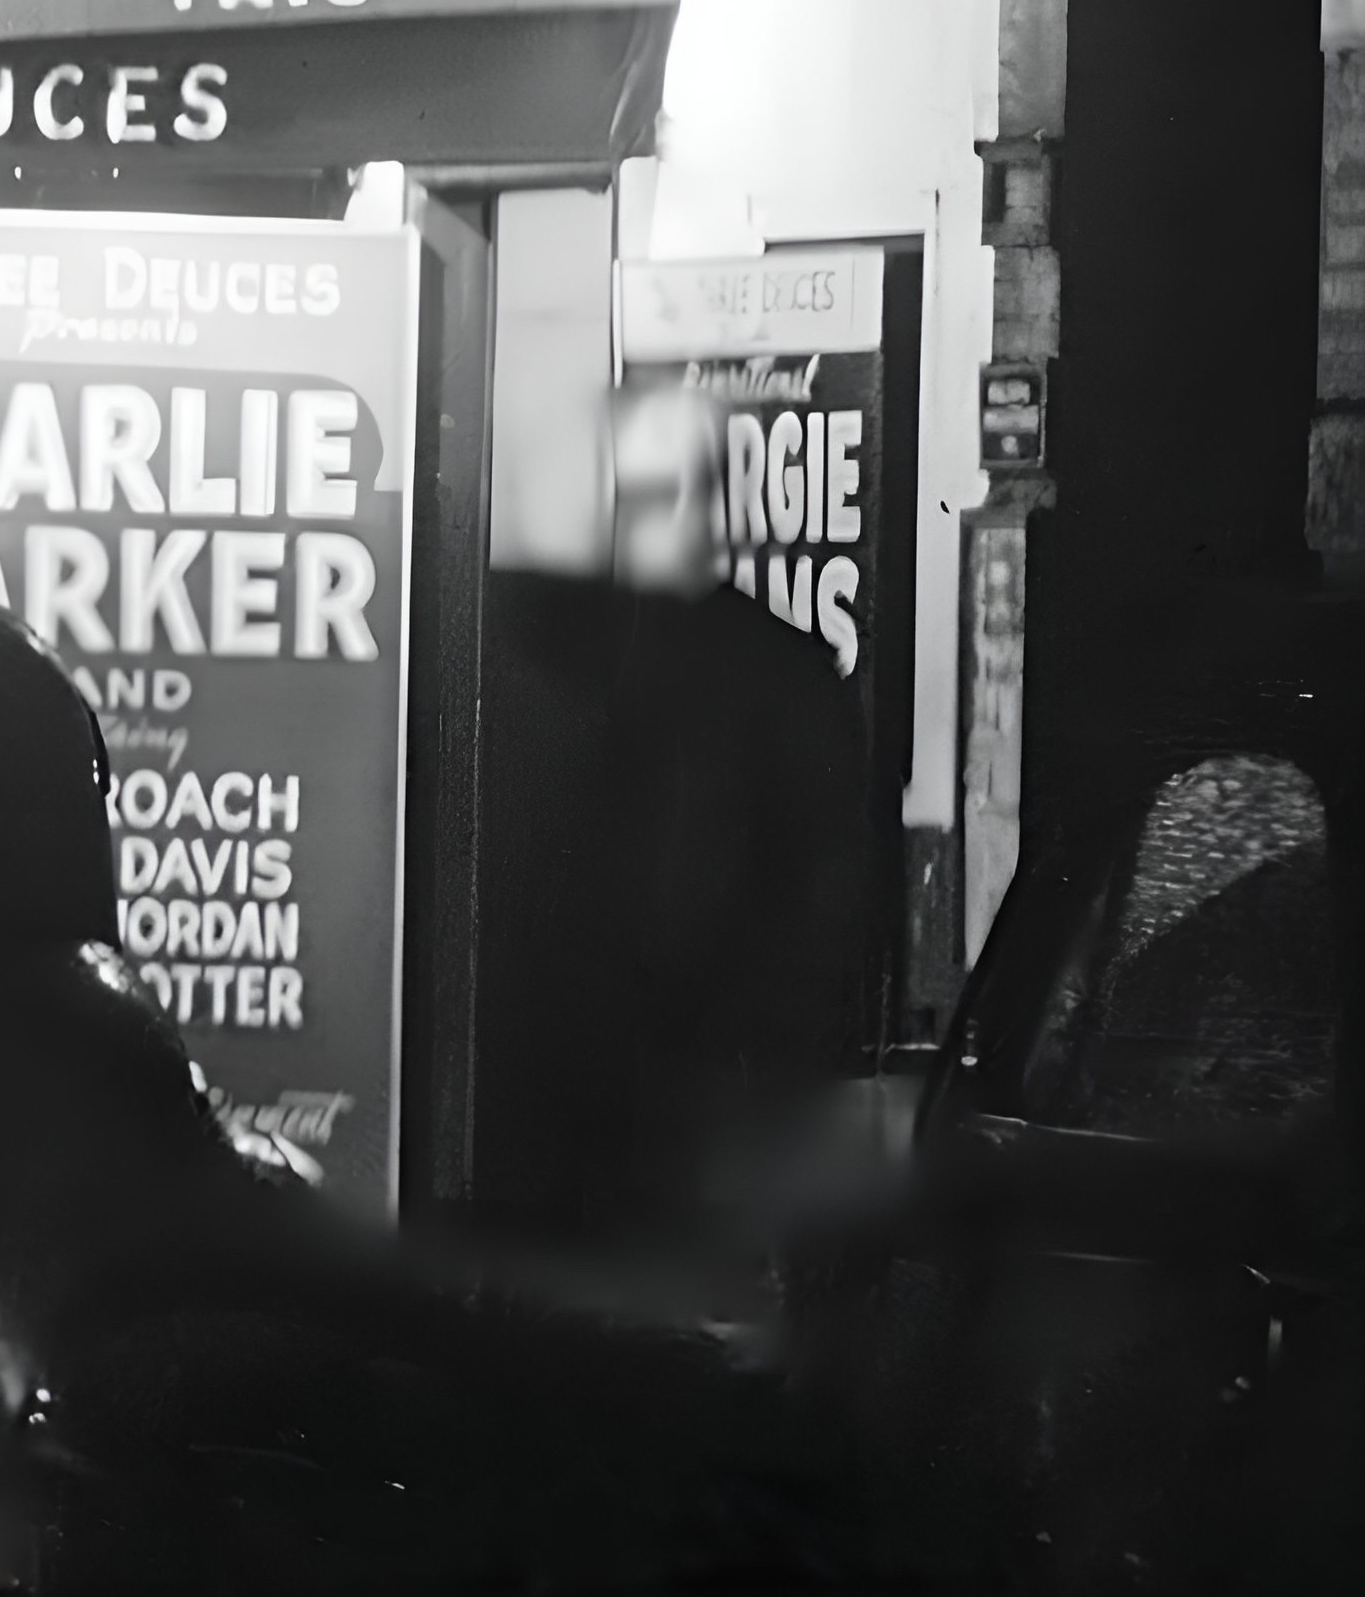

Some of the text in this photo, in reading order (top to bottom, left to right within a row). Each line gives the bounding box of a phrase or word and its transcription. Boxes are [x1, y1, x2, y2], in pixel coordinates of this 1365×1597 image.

[103, 245, 341, 317] DEUCES
[72, 666, 192, 711] AND
[121, 836, 293, 899] DAVIS
